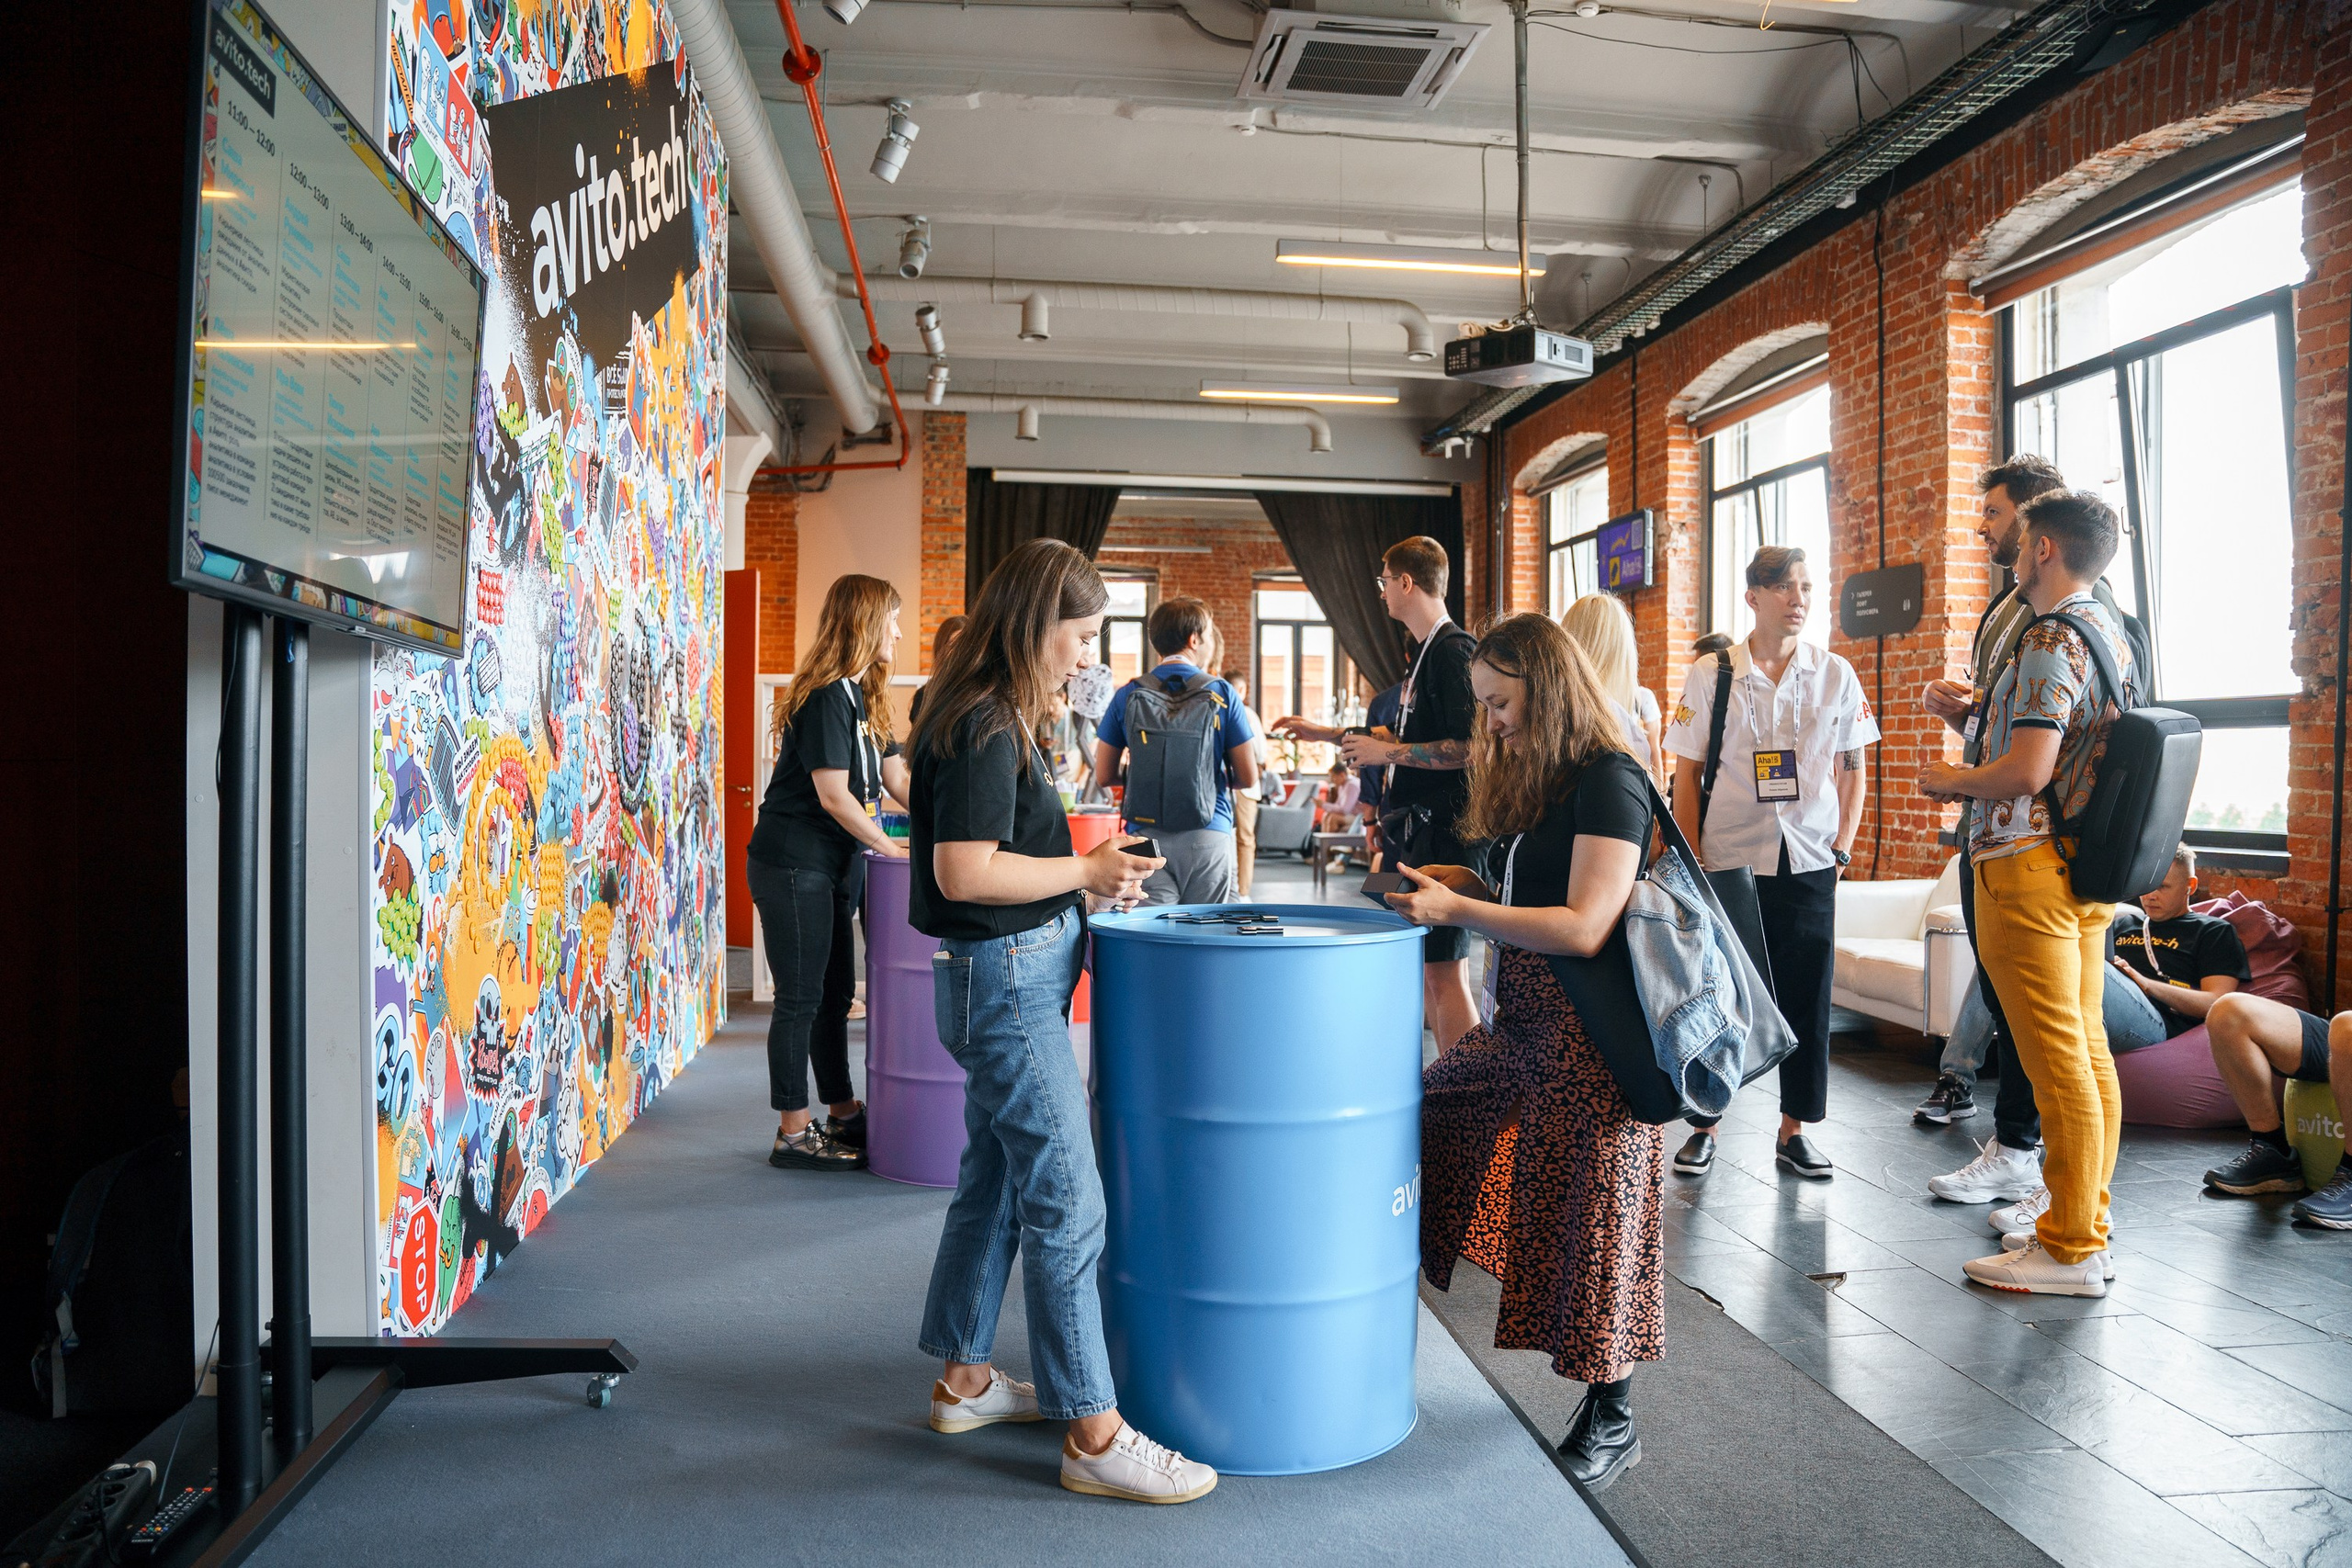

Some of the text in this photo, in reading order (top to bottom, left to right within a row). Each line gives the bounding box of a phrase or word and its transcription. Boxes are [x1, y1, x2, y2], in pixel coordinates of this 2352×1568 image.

[215, 29, 270, 99] avito.tech
[228, 101, 248, 130] 11:00
[256, 130, 276, 156] 12:00
[289, 163, 308, 188] 12:00
[313, 186, 329, 210] 13:00
[530, 105, 687, 318] avito.tech
[340, 212, 355, 235] 13:00
[359, 232, 374, 254] 14:00
[382, 255, 395, 278] 14:00
[463, 738, 479, 764] ЗНАЕМ
[414, 1215, 428, 1314] STOP
